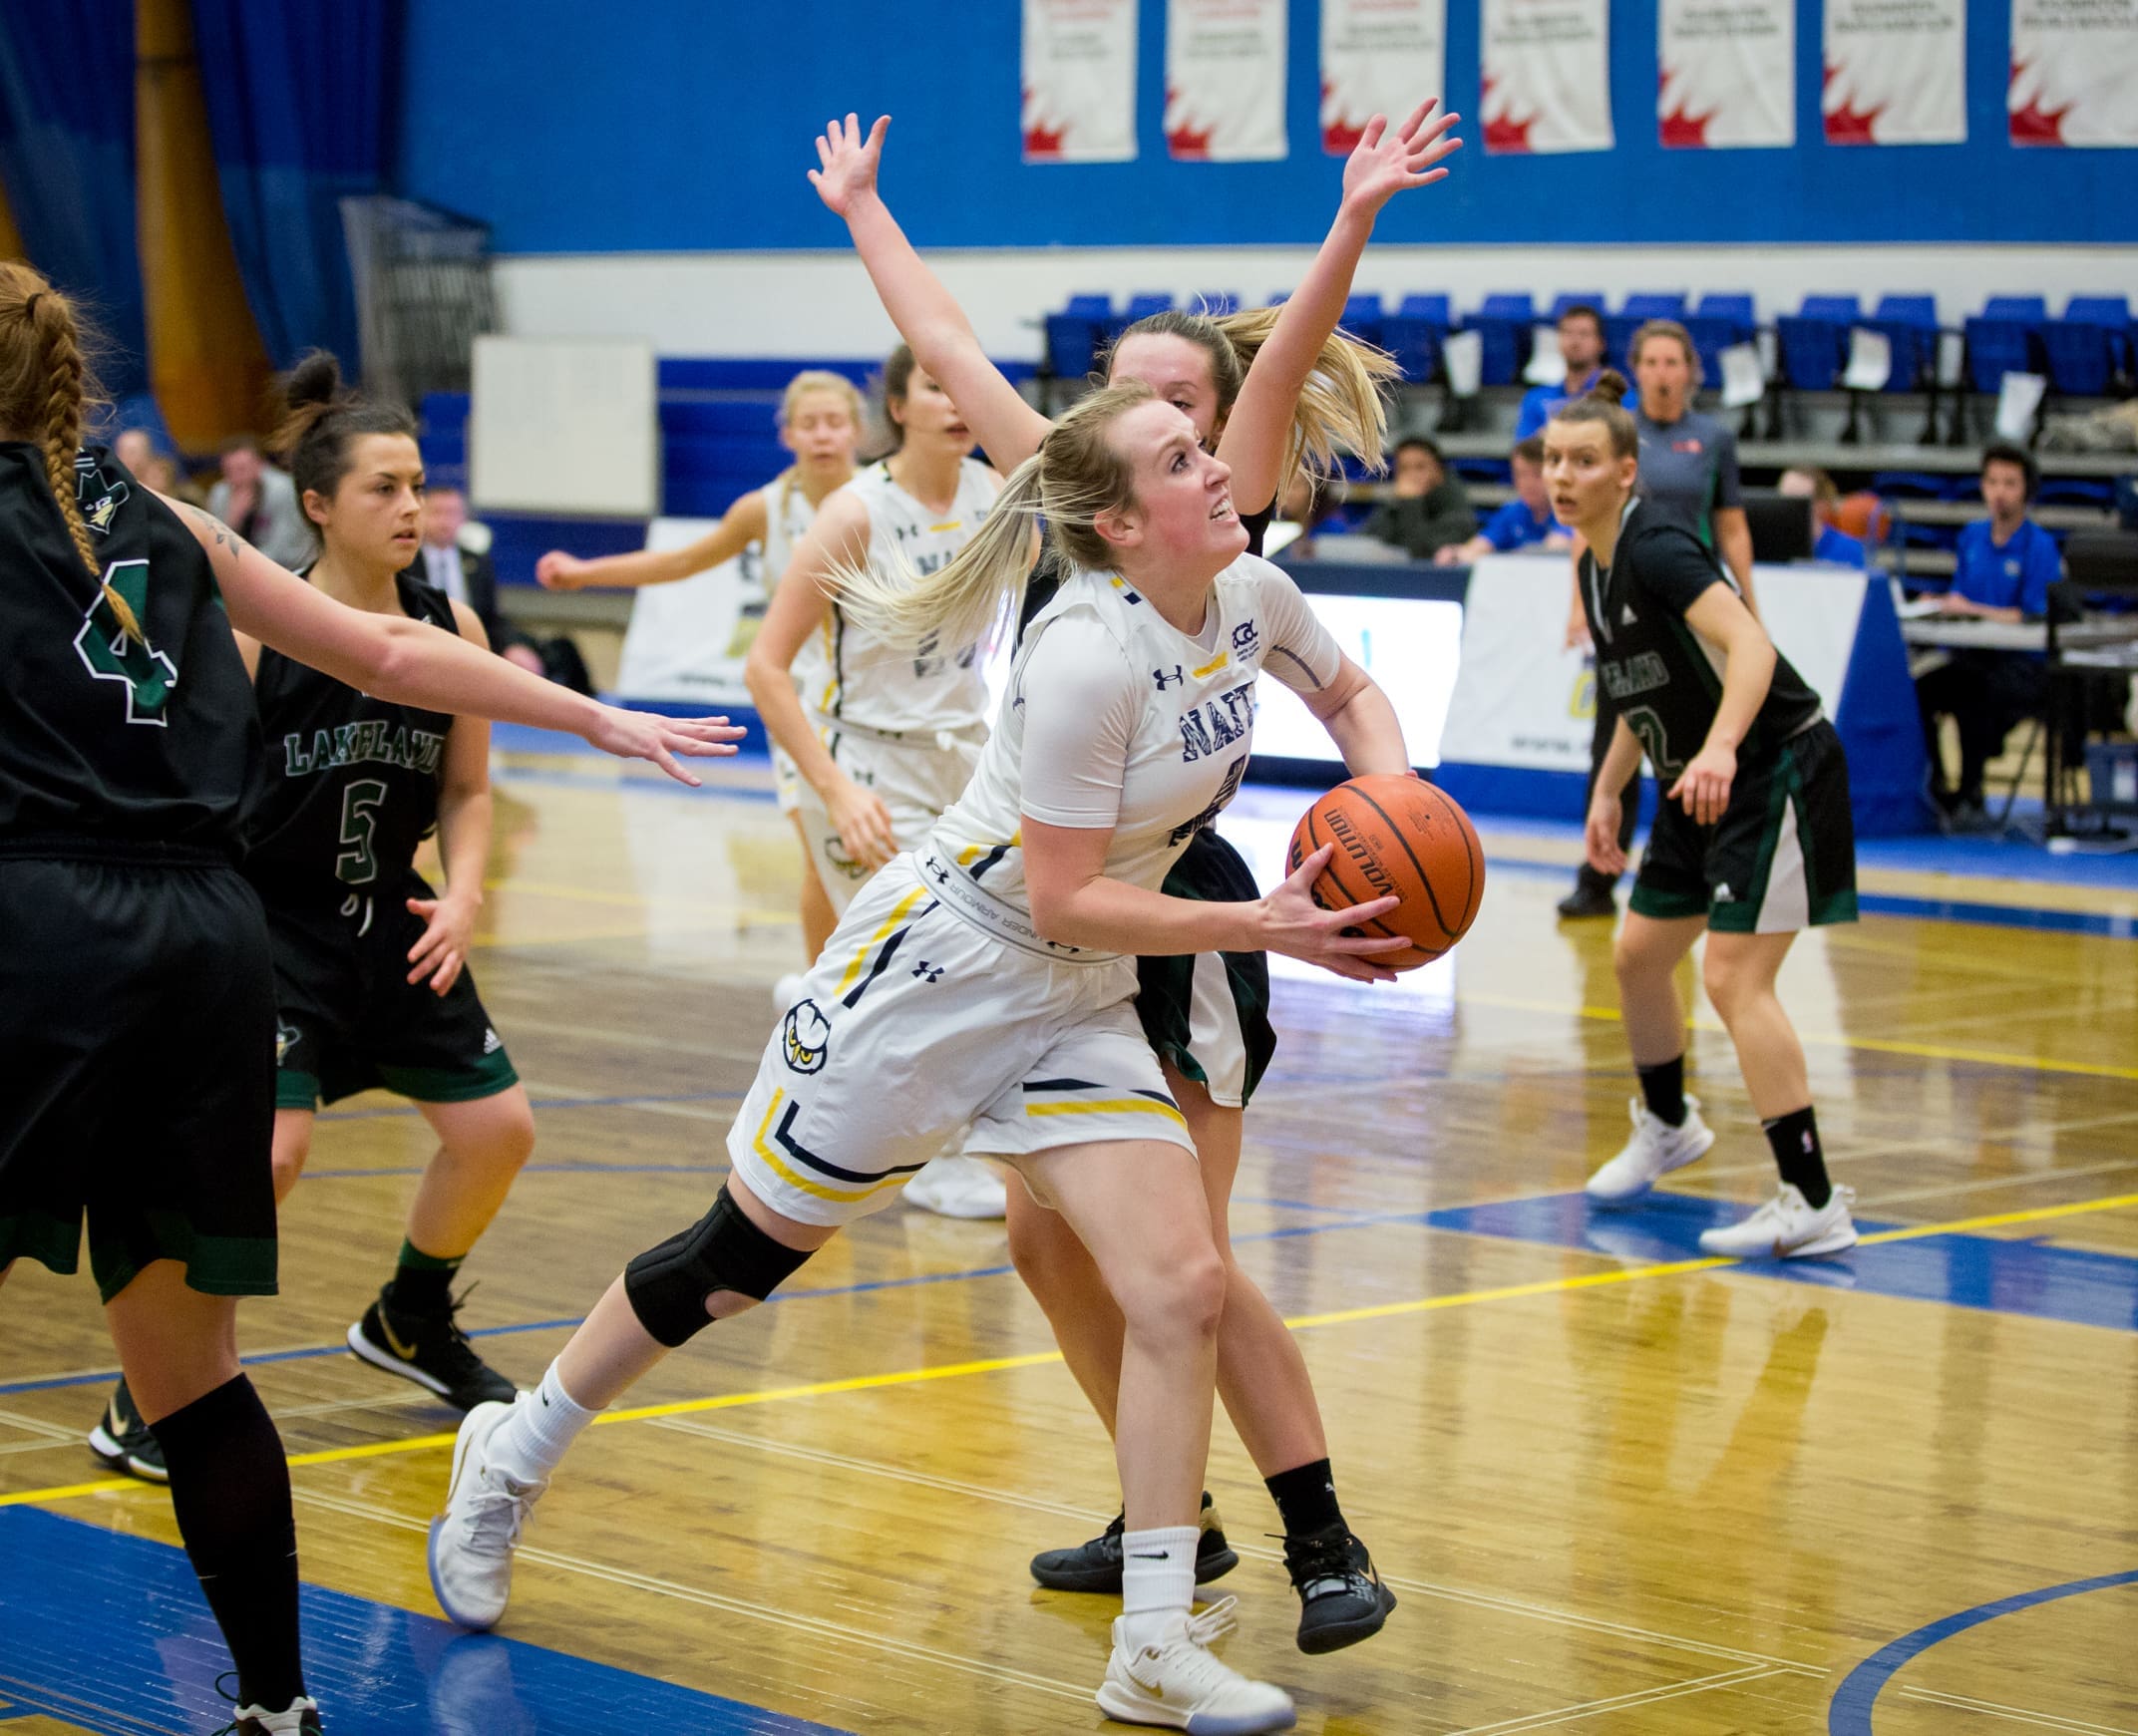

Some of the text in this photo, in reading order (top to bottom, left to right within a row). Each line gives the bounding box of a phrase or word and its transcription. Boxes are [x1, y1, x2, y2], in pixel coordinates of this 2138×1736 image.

[74, 559, 178, 727] 4
[1180, 681, 1253, 762] NAIT
[335, 778, 389, 885] 5
[1323, 808, 1395, 896] VOLUTION
[948, 881, 999, 921] ARMOUR
